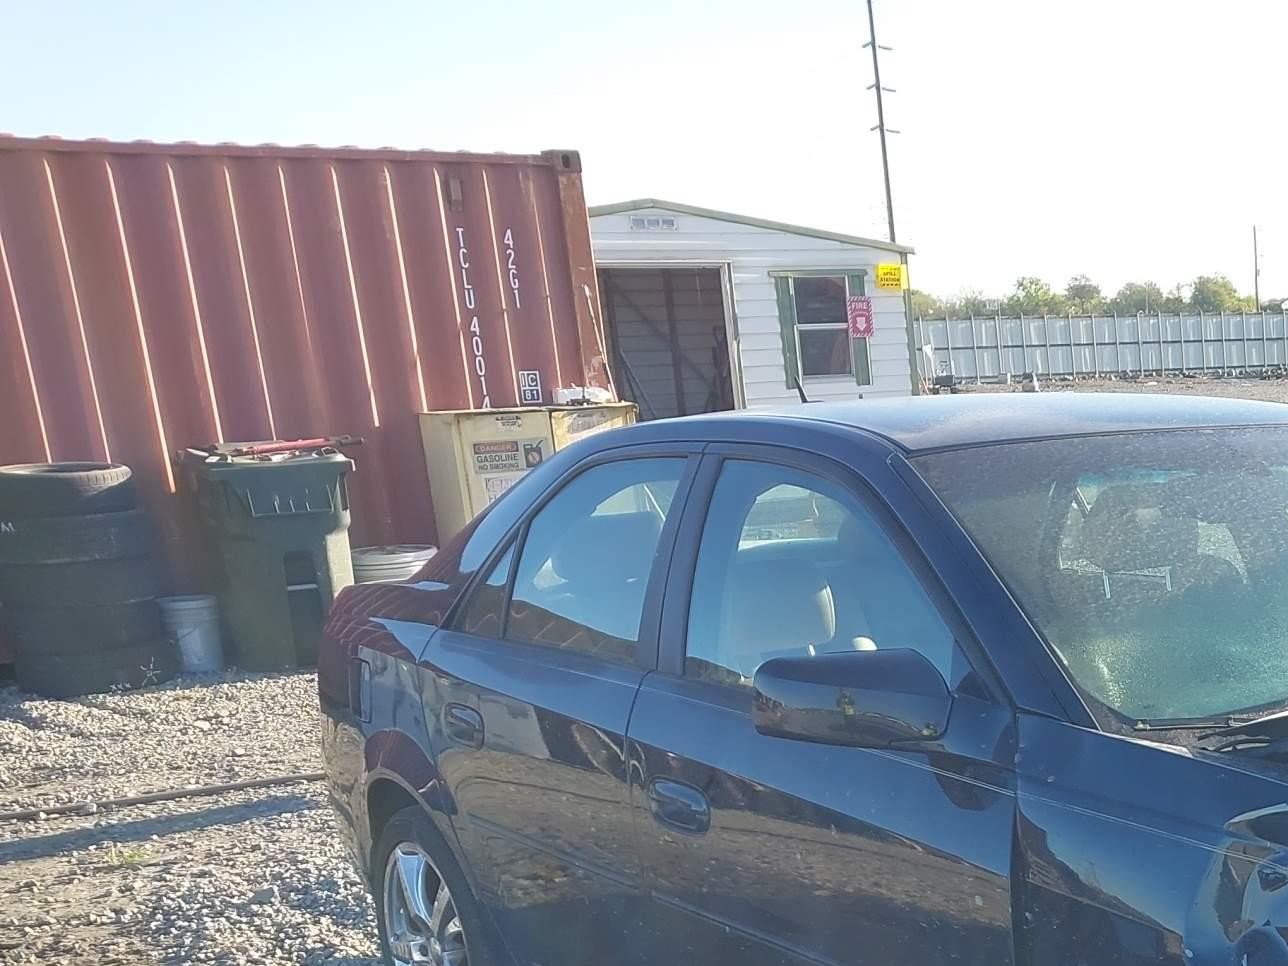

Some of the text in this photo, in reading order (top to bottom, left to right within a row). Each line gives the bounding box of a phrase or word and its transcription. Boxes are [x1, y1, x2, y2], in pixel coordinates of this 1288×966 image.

[455, 227, 475, 310] TCLU
[503, 228, 520, 309] 42G1
[851, 301, 869, 310] FIRE
[476, 453, 520, 463] GASOLINE
[478, 462, 520, 471] NO SMOKING
